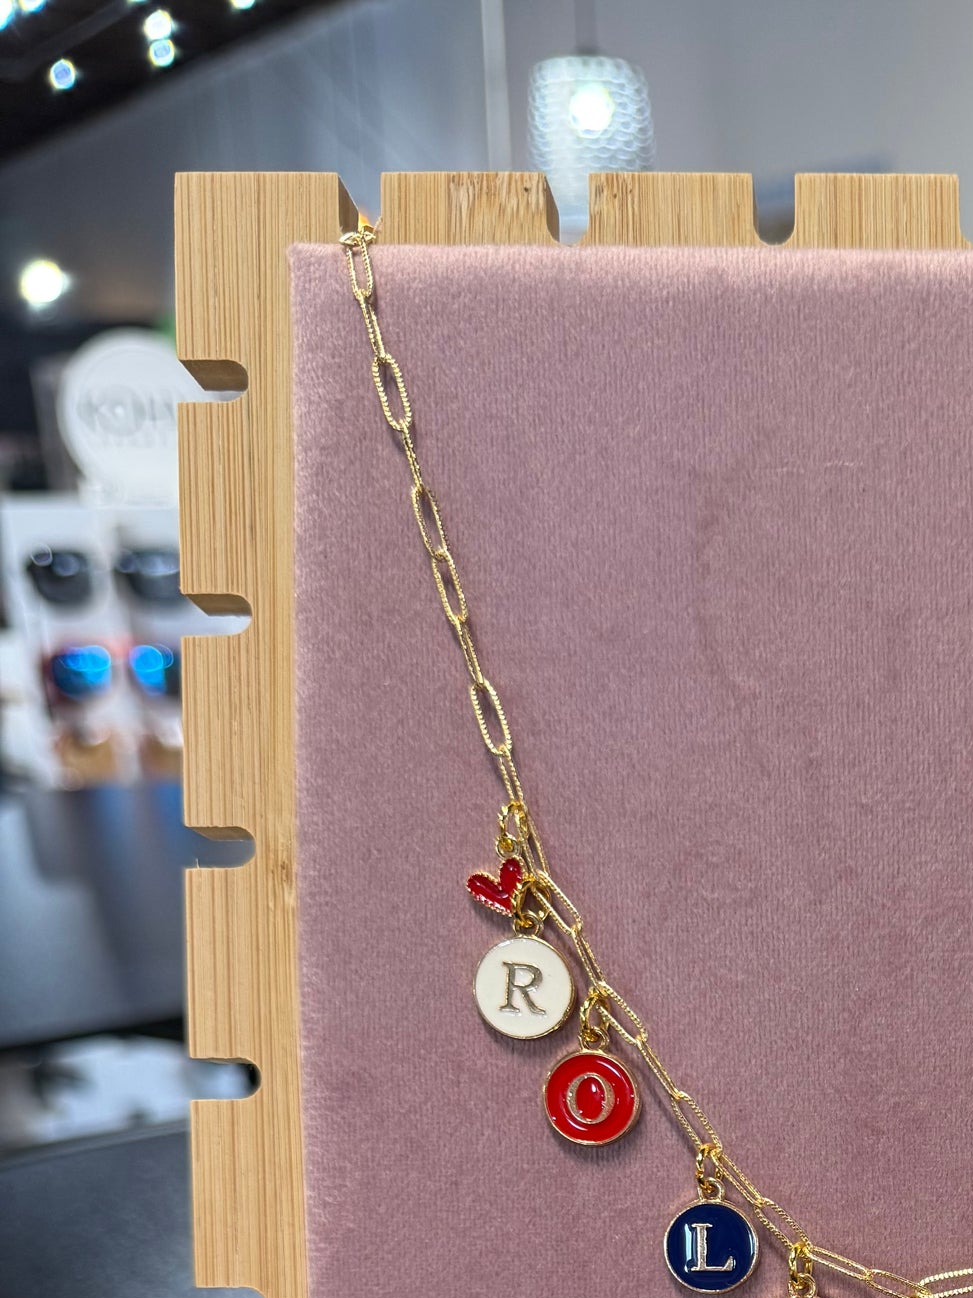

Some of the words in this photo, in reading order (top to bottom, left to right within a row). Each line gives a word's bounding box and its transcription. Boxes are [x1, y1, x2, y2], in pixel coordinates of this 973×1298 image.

[500, 961, 546, 1016] R
[566, 1072, 616, 1125] O
[690, 1223, 735, 1272] L
